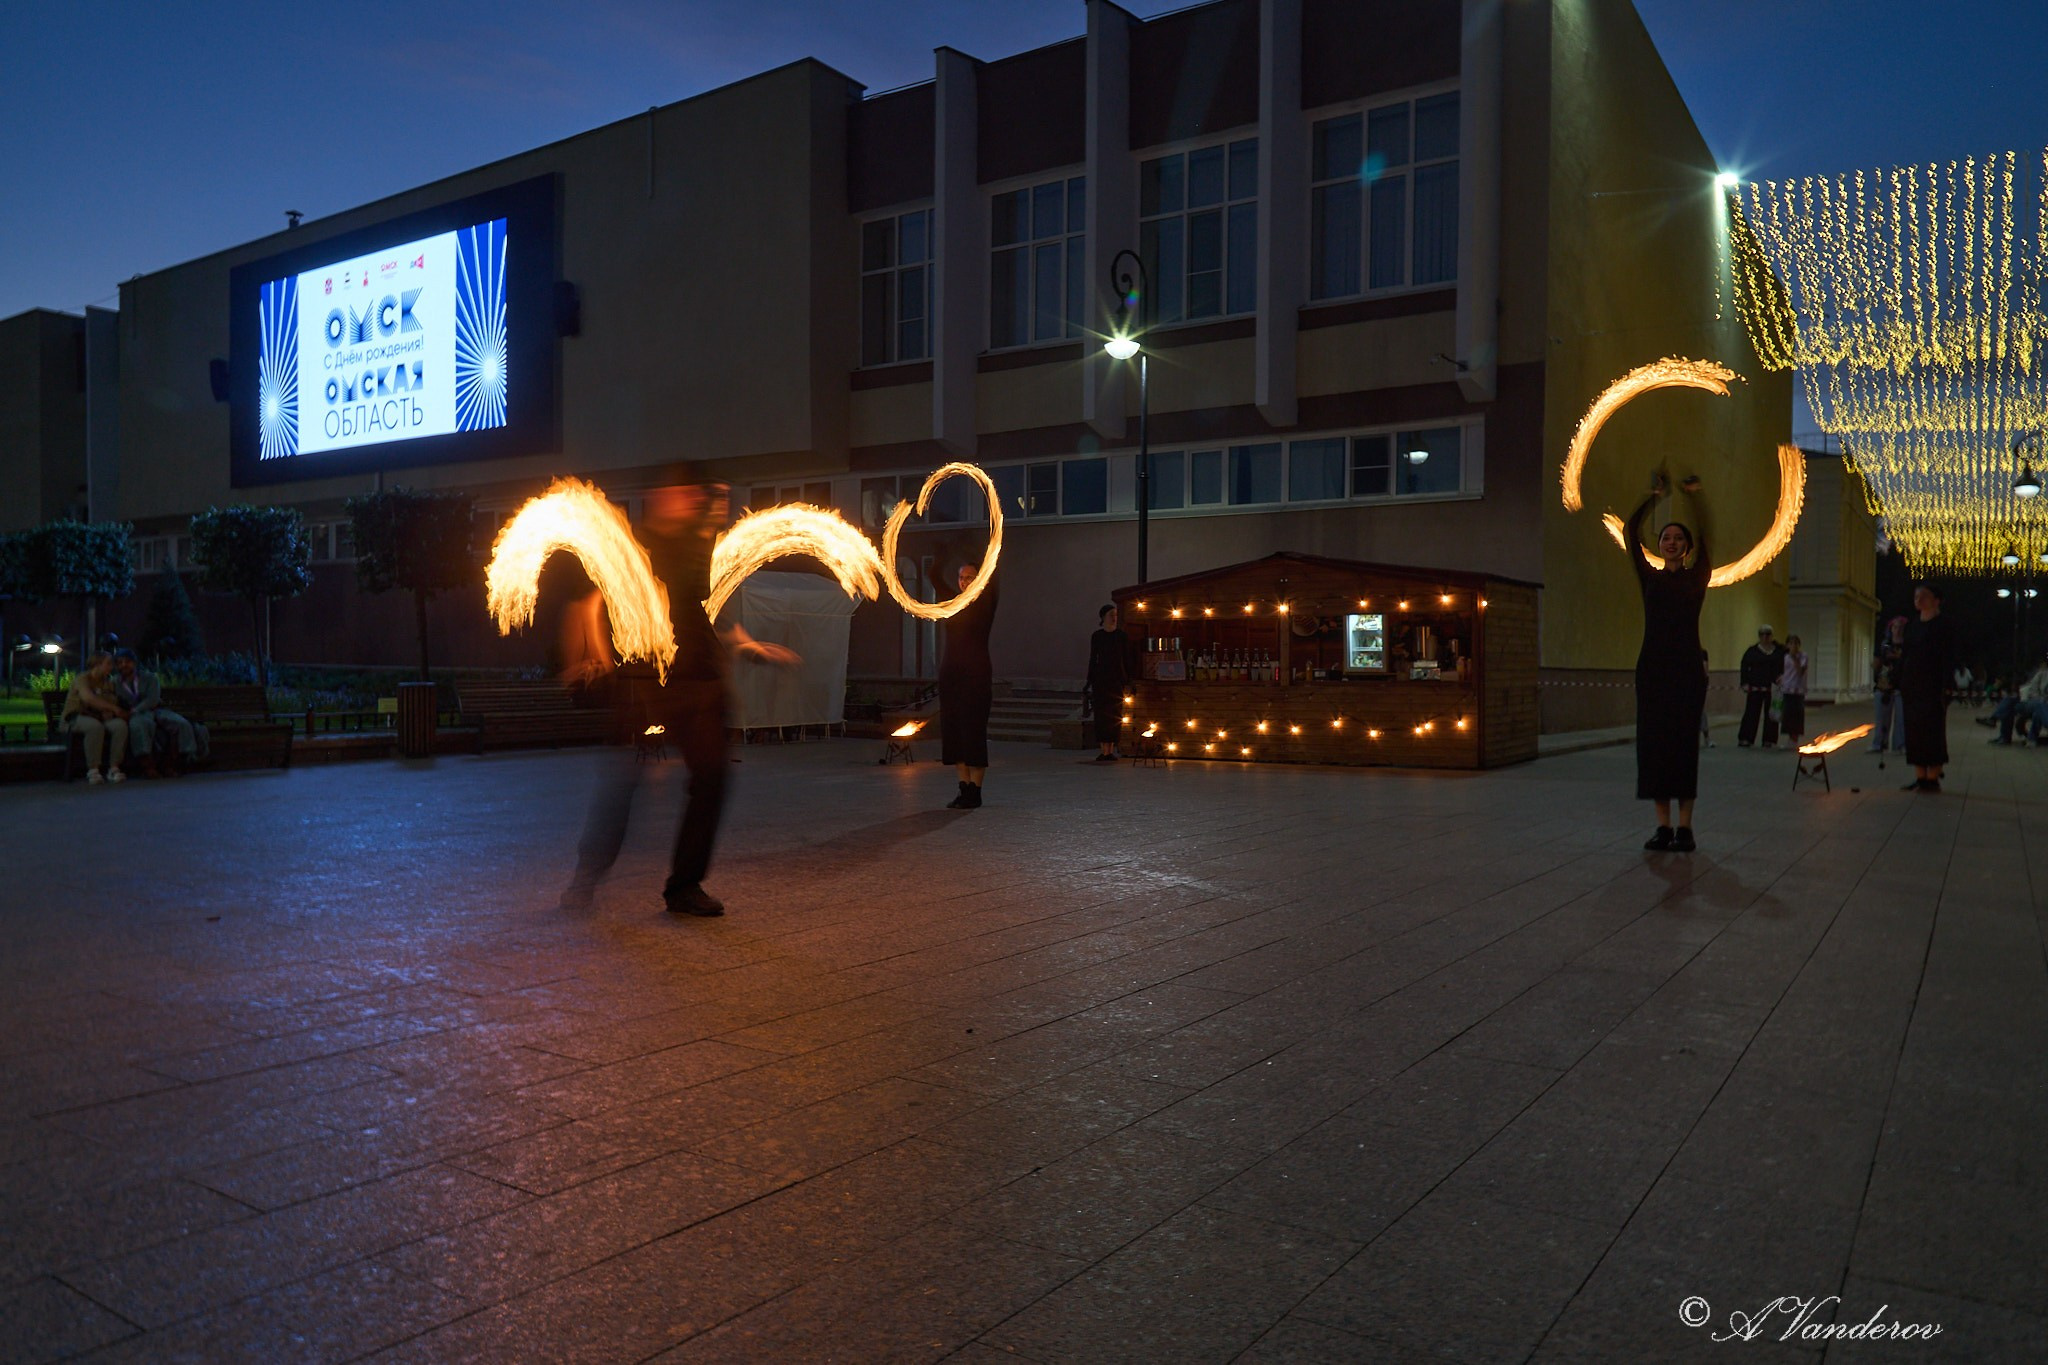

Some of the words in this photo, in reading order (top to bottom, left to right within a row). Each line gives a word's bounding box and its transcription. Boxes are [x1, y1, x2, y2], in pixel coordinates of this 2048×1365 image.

[324, 287, 424, 349] ОМСК
[334, 347, 363, 370] Днём
[365, 335, 424, 365] рождения!
[324, 360, 424, 405] ОМСКАЯ
[324, 397, 424, 439] ОБЛАСТЬ
